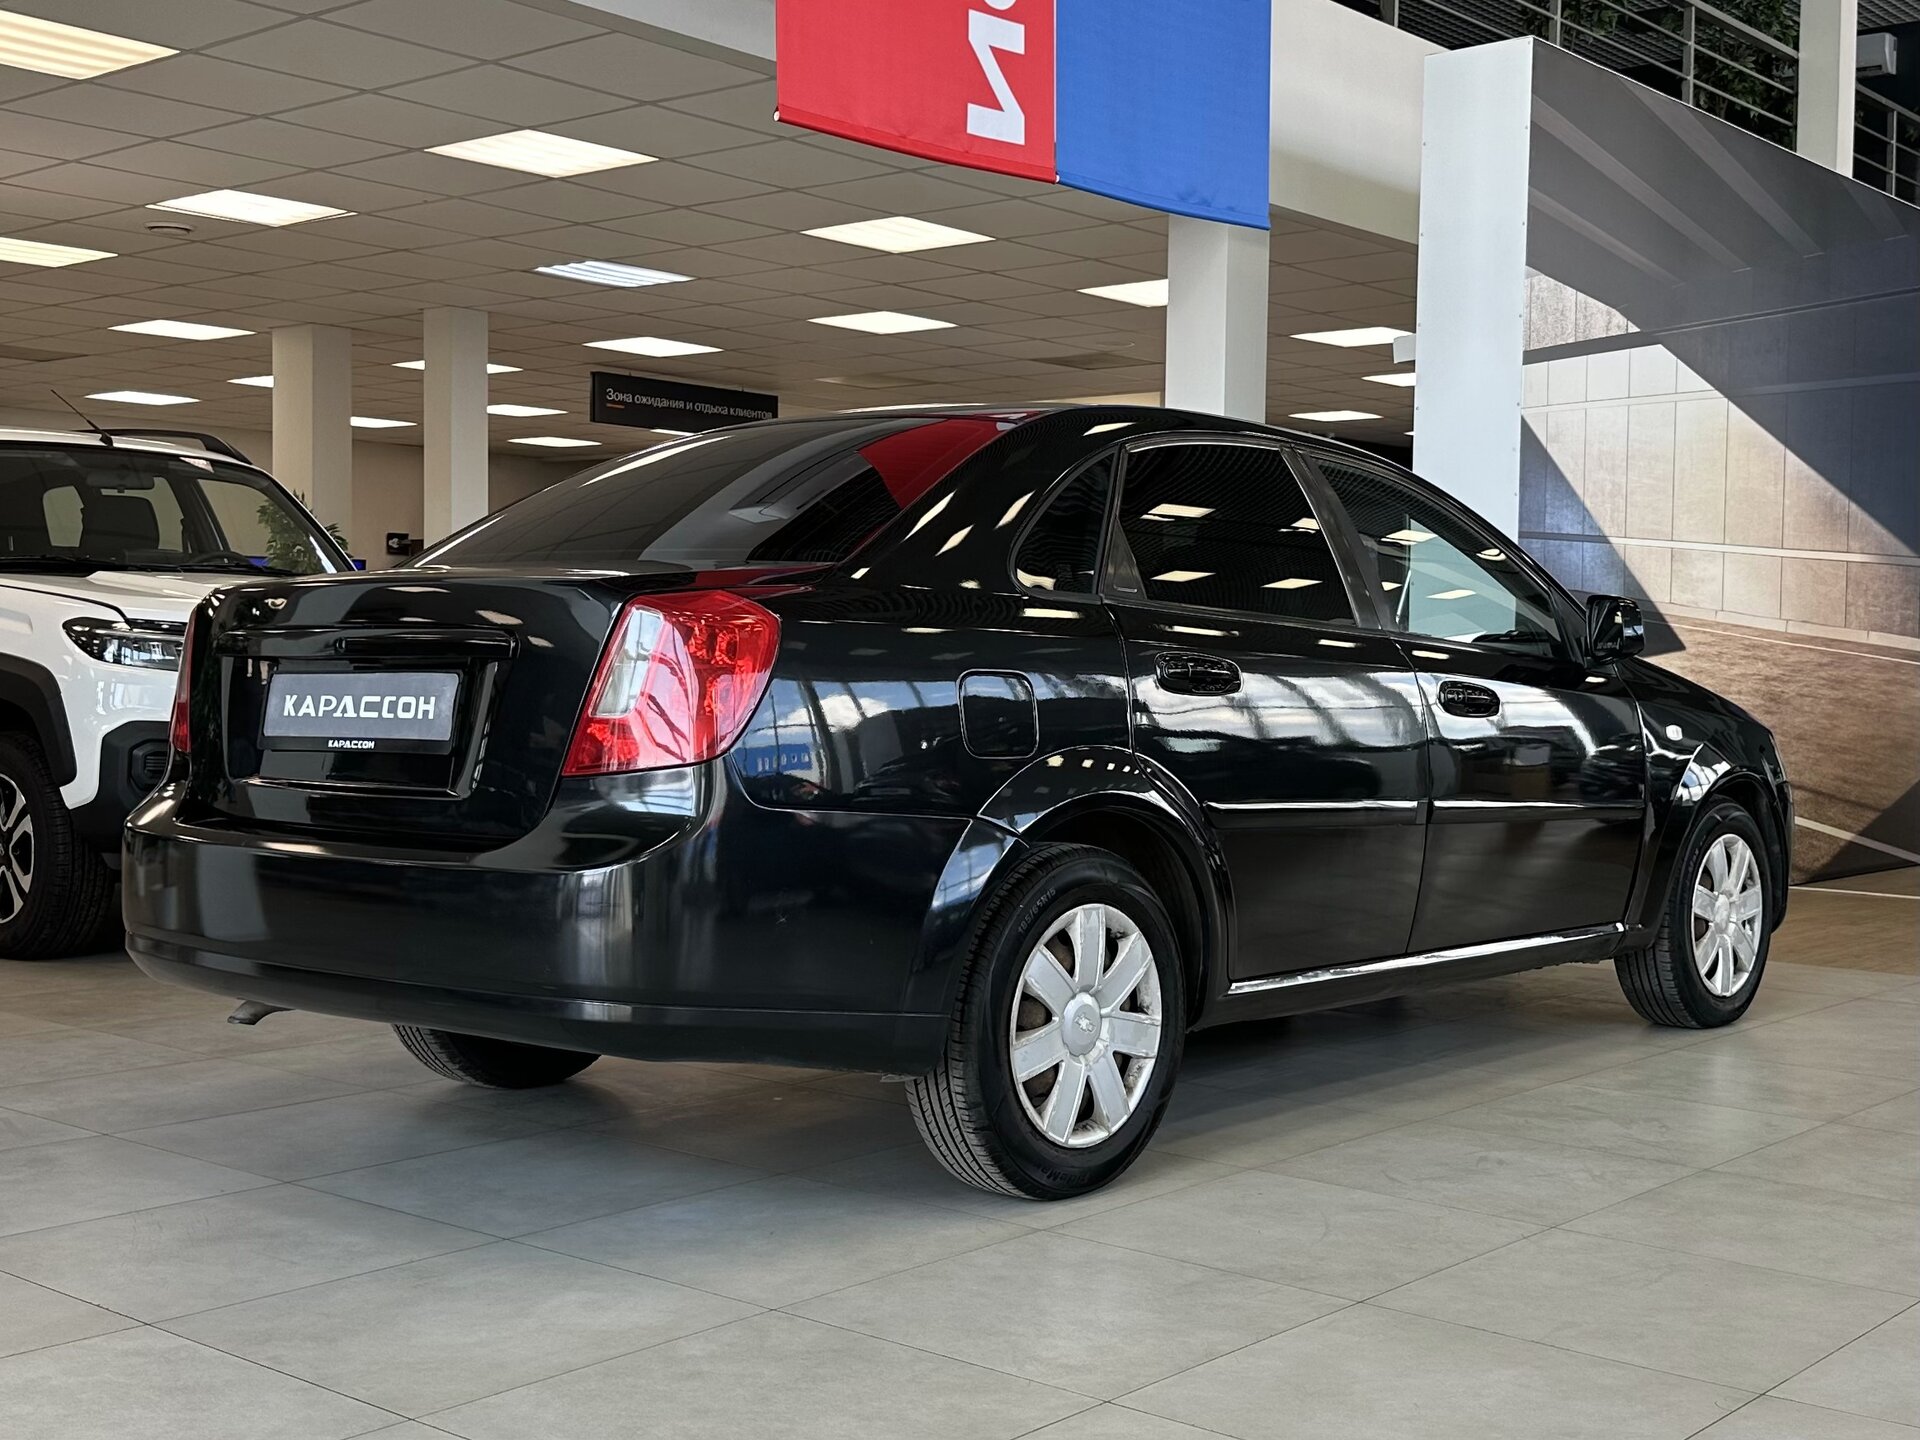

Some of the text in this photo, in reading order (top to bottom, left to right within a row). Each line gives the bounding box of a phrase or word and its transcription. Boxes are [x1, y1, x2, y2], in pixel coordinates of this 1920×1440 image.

[605, 387, 633, 403] Зона
[634, 394, 685, 411] ожидания
[686, 401, 693, 410] и
[694, 402, 728, 416] отдыха
